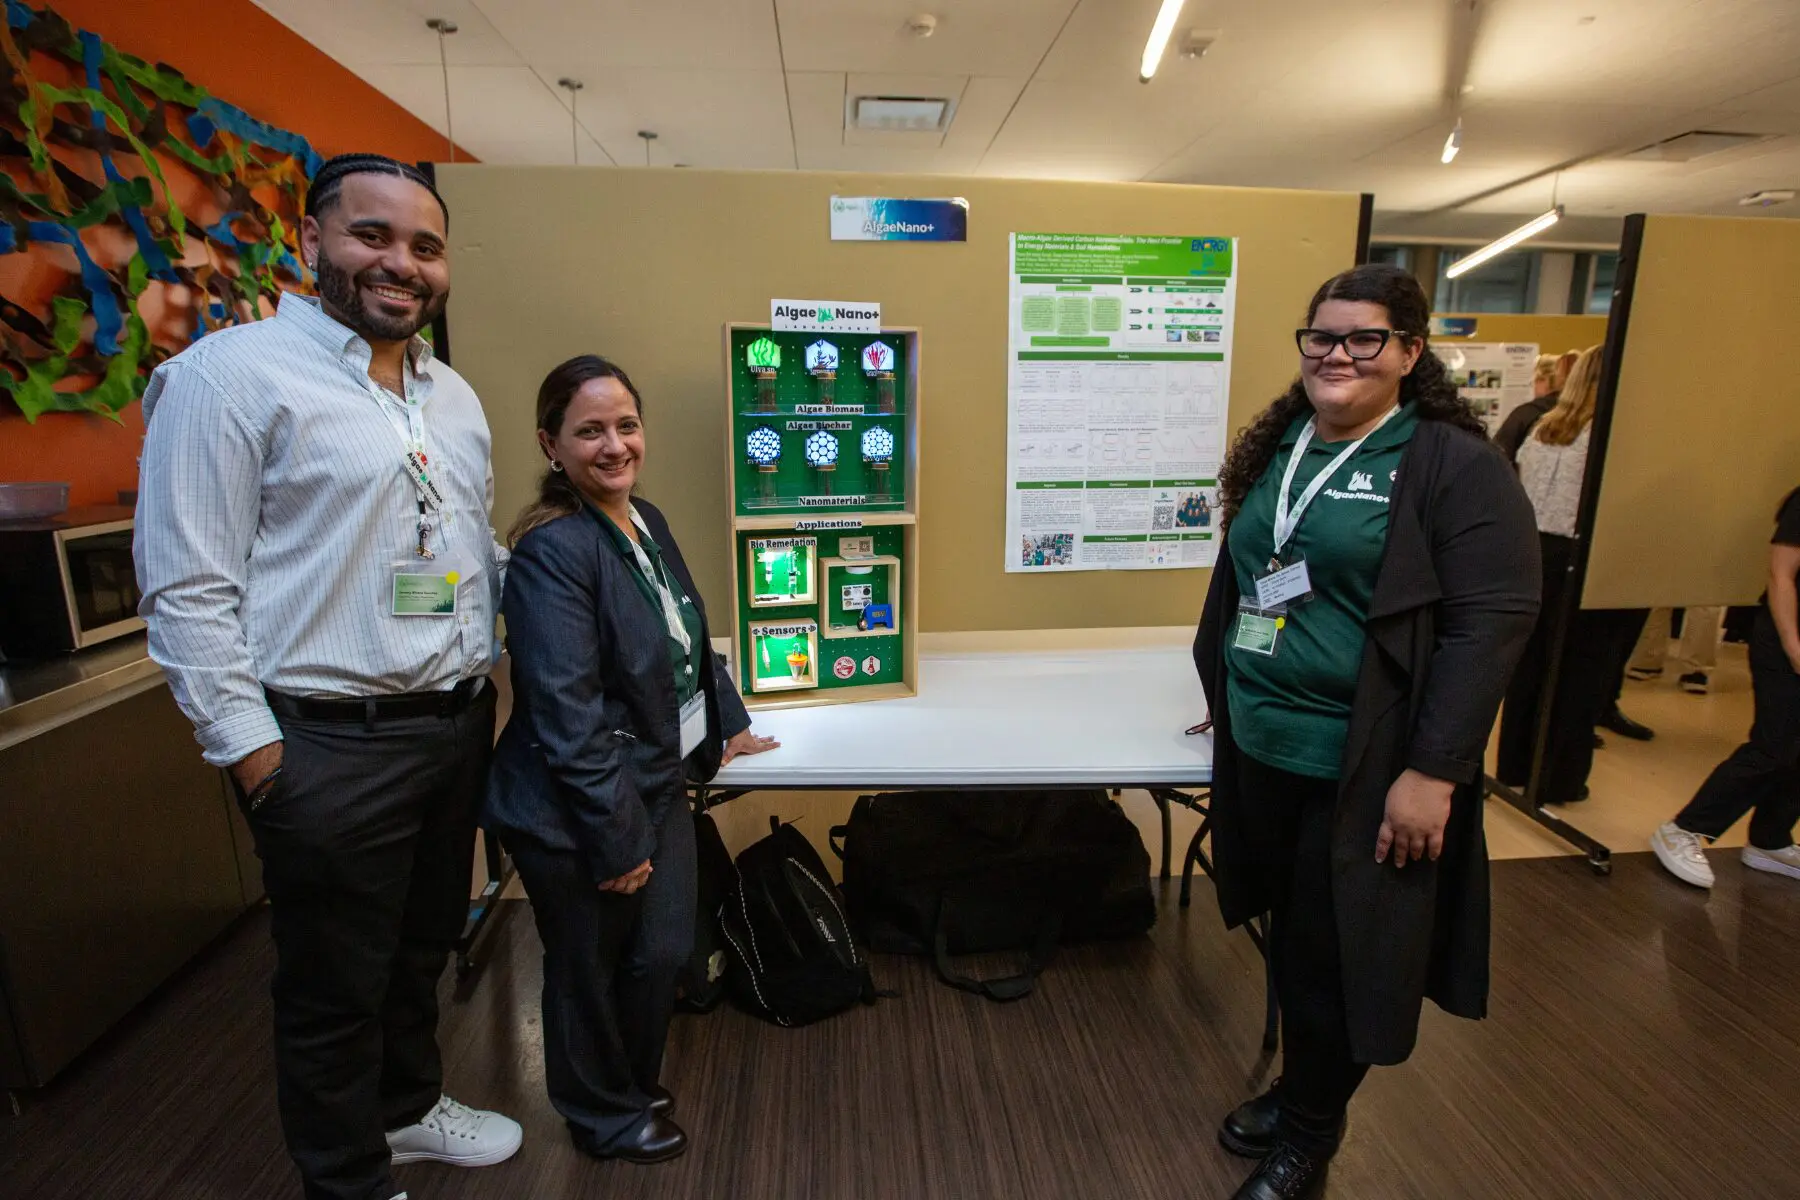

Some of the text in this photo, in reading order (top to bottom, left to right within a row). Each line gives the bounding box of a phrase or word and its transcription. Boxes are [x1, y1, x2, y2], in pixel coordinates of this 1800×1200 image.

[863, 221, 935, 234] AlgaeNano+
[775, 306, 880, 321] Algae Nano+
[796, 404, 864, 414] Algae Biomass
[787, 421, 851, 430] Algae Biochar
[407, 452, 423, 474] Algae
[1323, 488, 1390, 503] AlgaeNano+
[799, 496, 866, 506] Nanomaterials
[796, 520, 862, 530] Applications
[750, 538, 816, 549] Bio Remedation
[761, 626, 807, 635] Sensors
